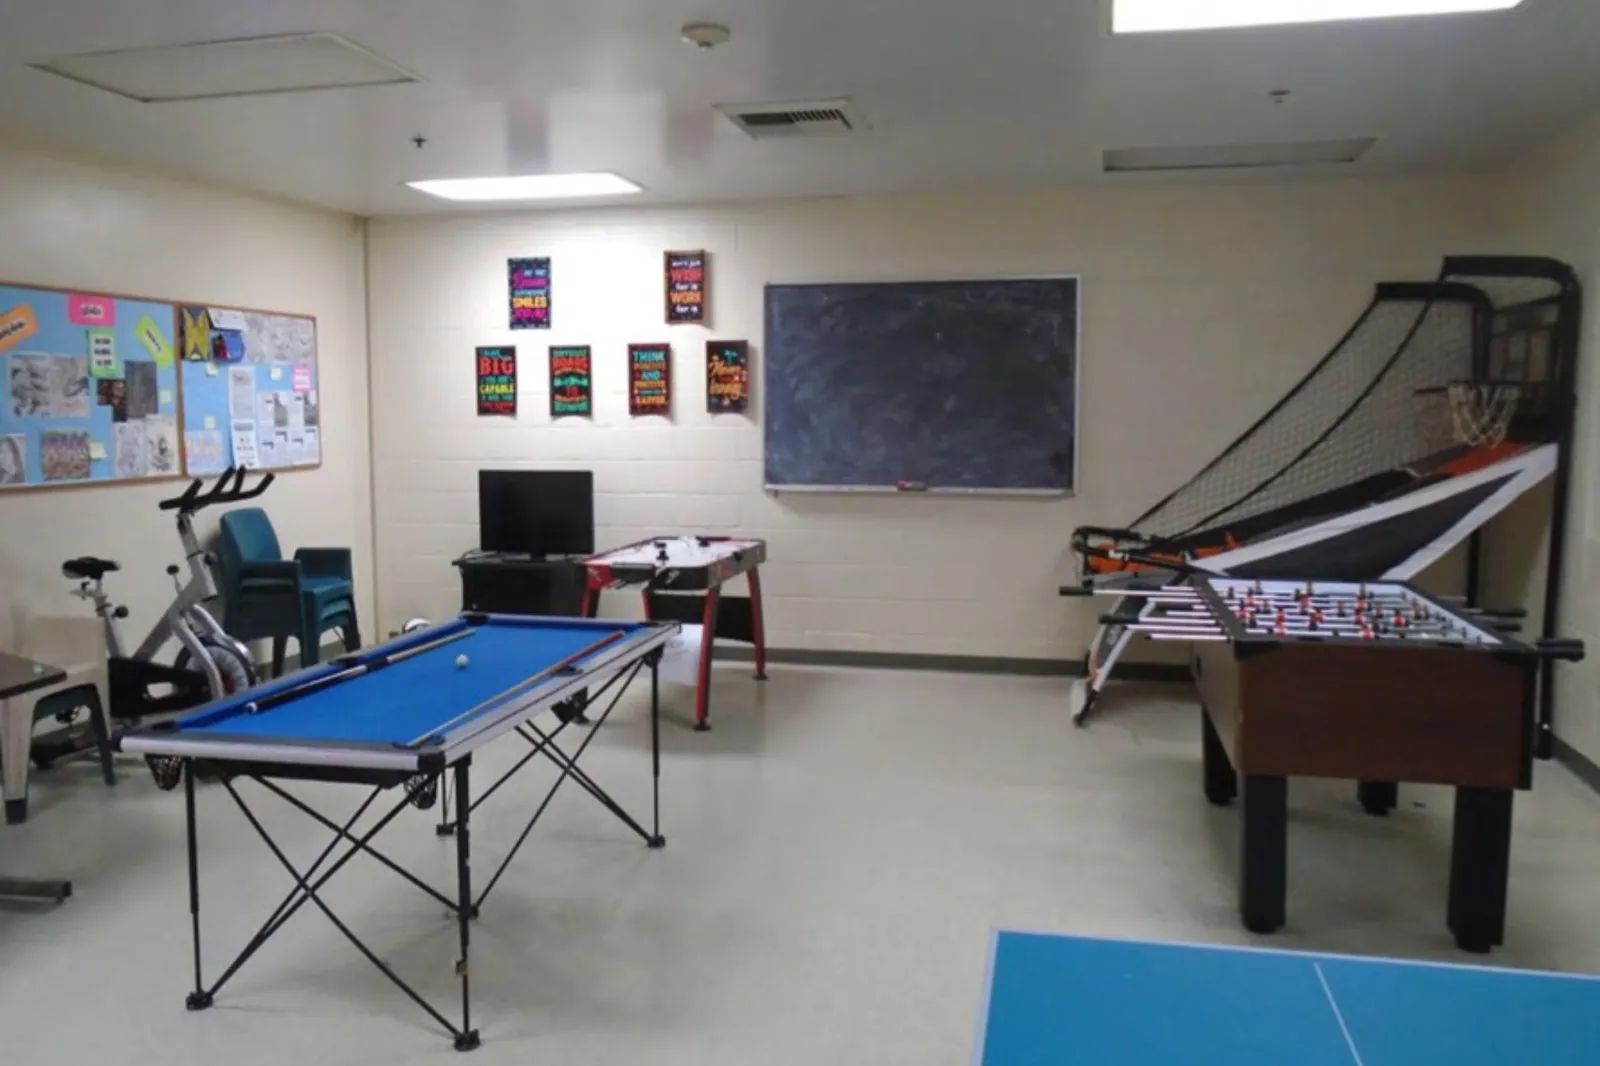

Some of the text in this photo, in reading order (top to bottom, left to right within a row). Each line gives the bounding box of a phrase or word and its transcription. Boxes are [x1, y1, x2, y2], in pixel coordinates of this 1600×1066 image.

[513, 297, 547, 308] SMILES
[634, 351, 666, 362] THINK
[480, 357, 513, 375] BIG
